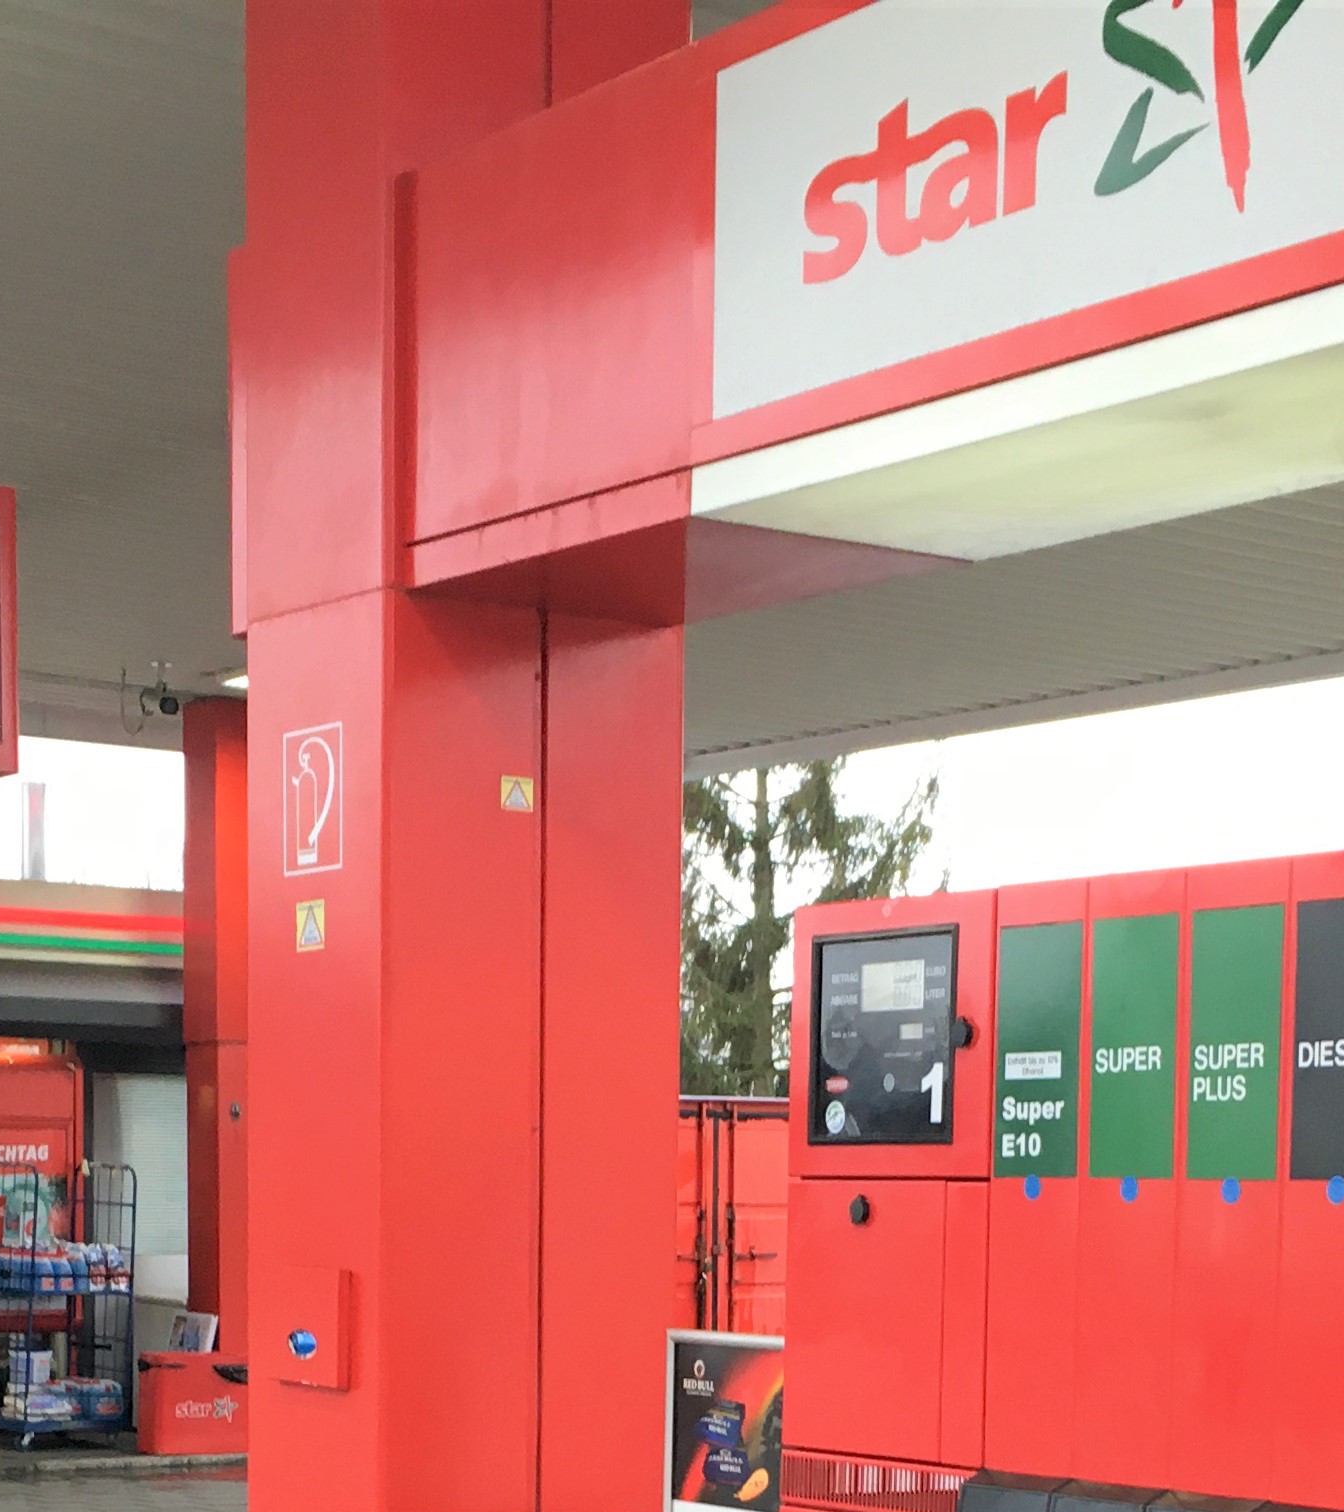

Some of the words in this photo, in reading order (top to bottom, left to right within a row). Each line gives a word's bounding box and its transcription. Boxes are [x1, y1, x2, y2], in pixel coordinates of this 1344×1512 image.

[802, 69, 1068, 285] star
[926, 965, 947, 977] EURO
[1095, 1045, 1162, 1074] SUPER
[1194, 1042, 1265, 1071] SUPER
[921, 1062, 944, 1124] 1
[1193, 1074, 1247, 1102] PLUS
[1002, 1096, 1065, 1126] Super
[1002, 1132, 1042, 1158] E10
[175, 1400, 212, 1418] star
